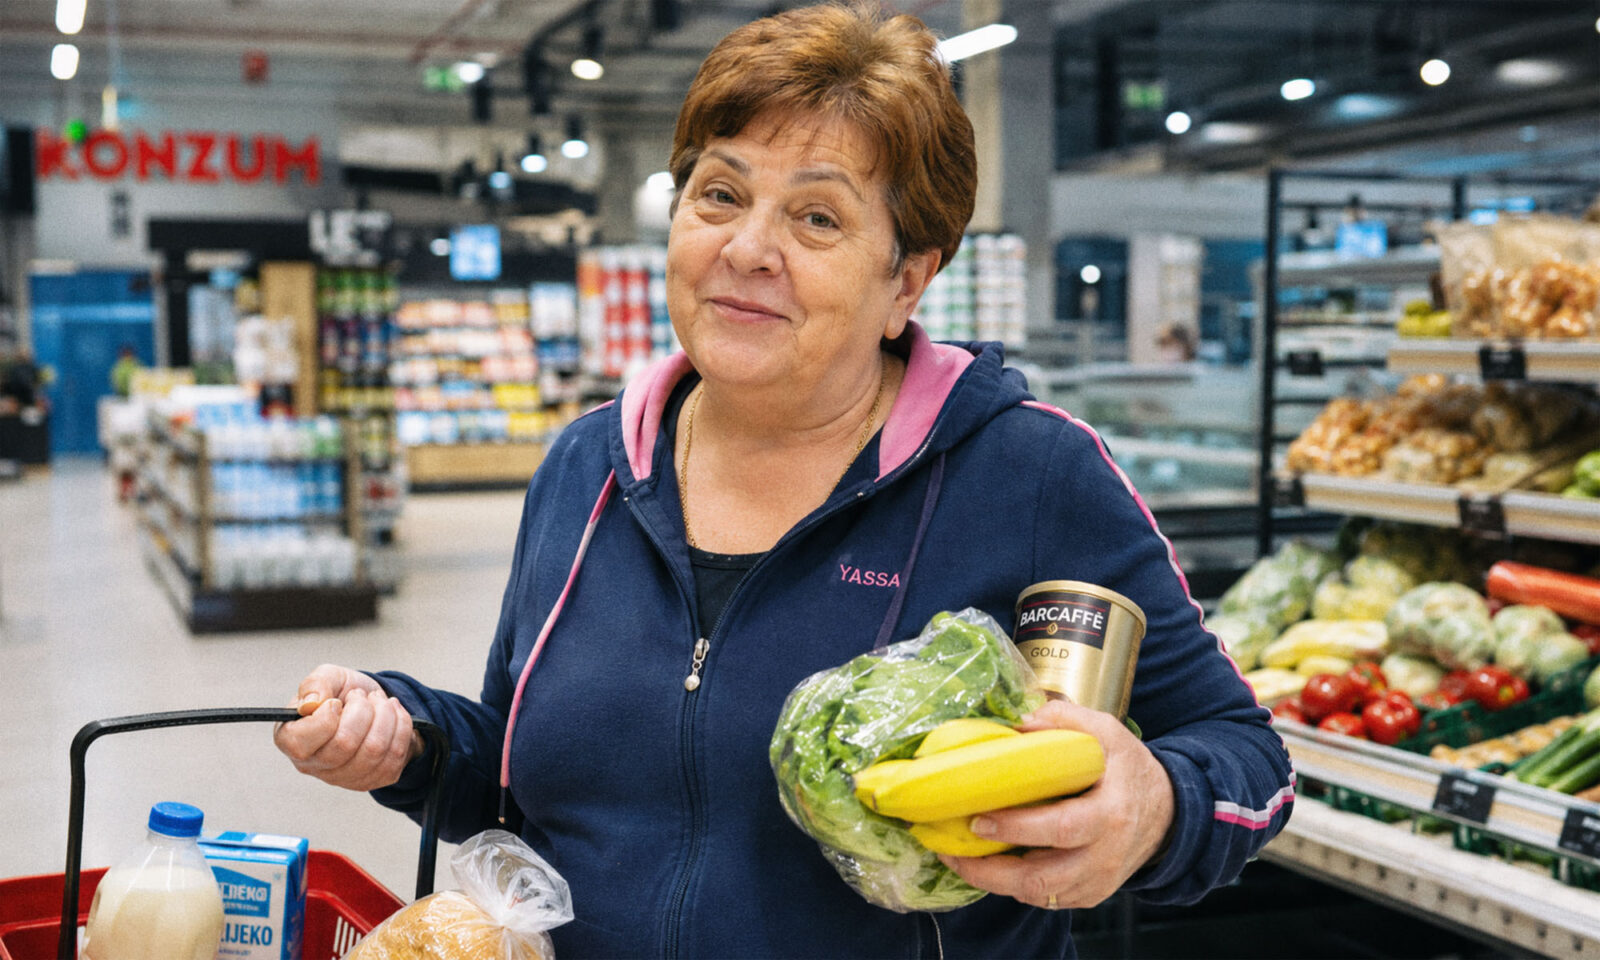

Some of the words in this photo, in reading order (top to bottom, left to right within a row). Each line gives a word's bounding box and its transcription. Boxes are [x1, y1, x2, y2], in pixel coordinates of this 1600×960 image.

[36, 129, 320, 185] KONZUM
[840, 564, 900, 587] YASSA
[1030, 647, 1070, 659] GOLD
[220, 922, 273, 947] IJEKO
